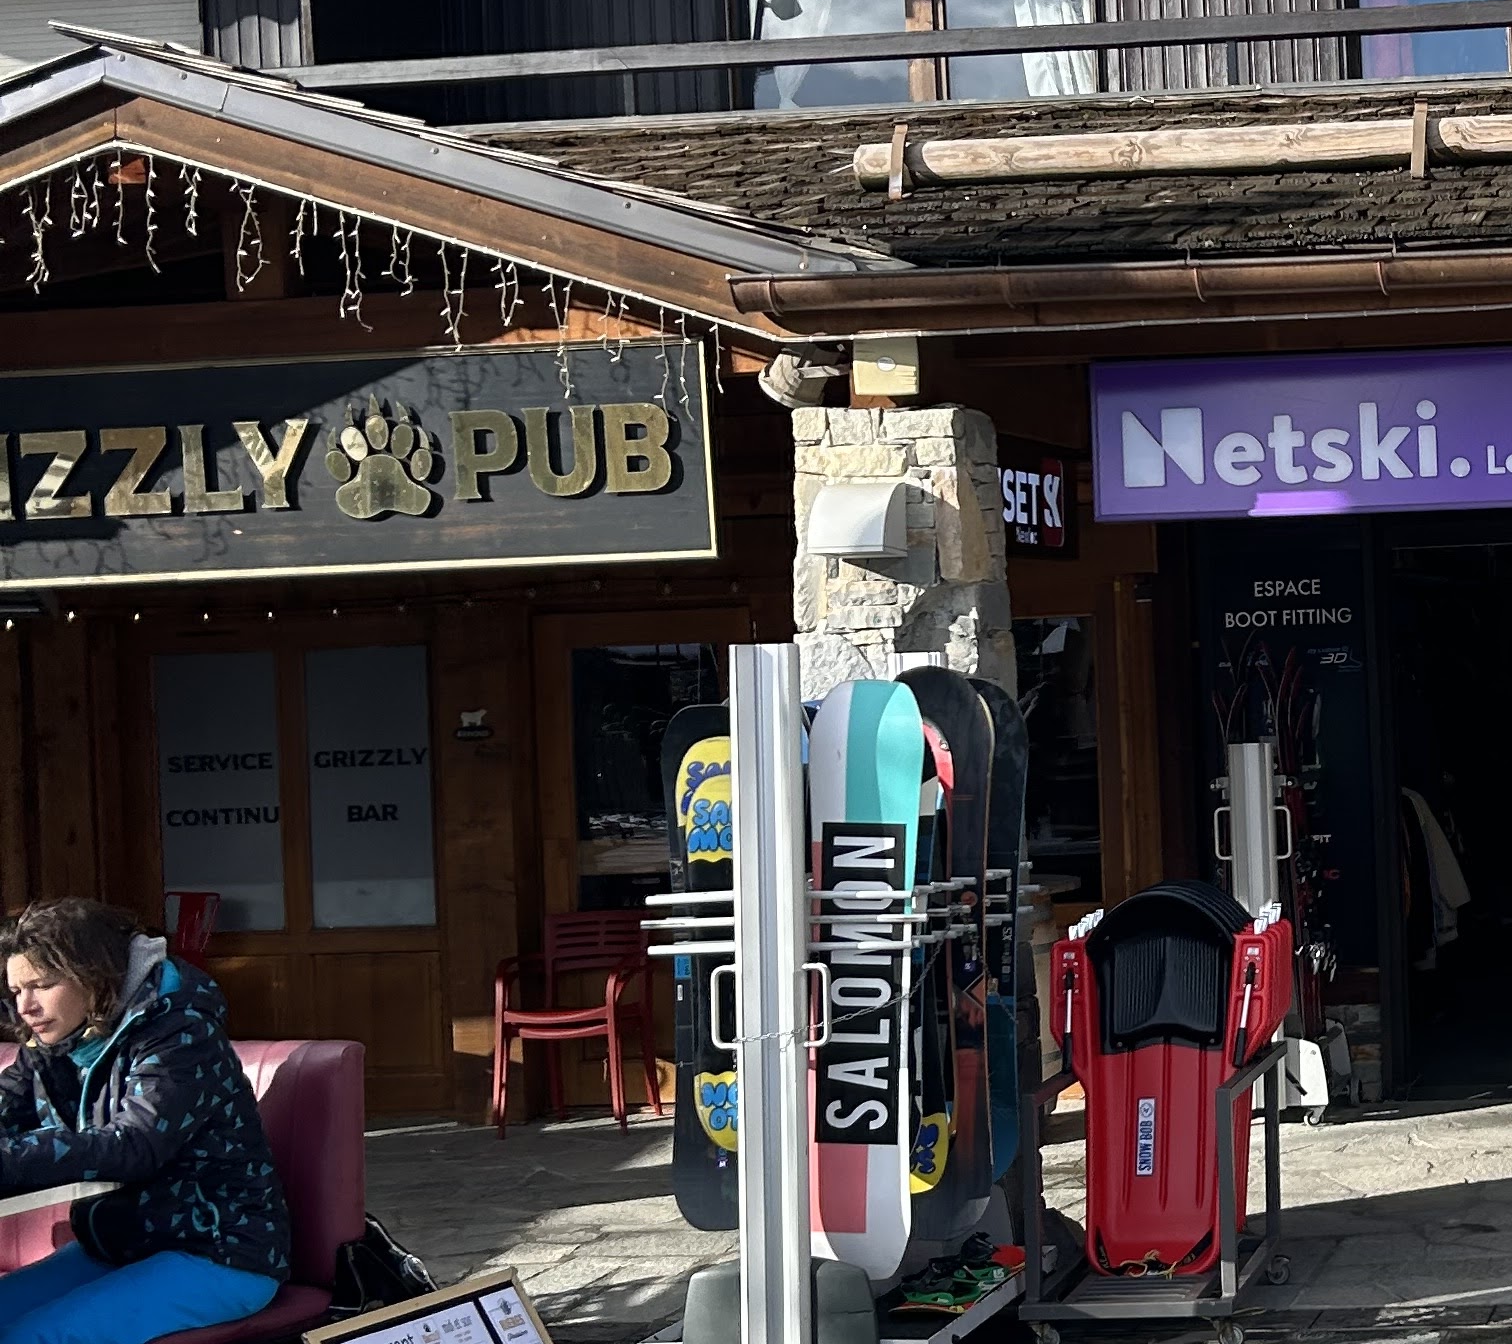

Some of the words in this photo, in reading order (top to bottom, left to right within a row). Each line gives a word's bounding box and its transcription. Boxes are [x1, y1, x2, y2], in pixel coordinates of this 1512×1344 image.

[450, 401, 673, 501] PUB
[1253, 578, 1321, 598] ESPACE
[1225, 607, 1277, 629] BOOT
[1281, 606, 1352, 627] FITTING
[167, 752, 273, 774] SERVICE
[314, 747, 428, 769] GRIZZLY
[166, 806, 280, 827] CONTINU
[347, 803, 398, 824] BAR
[826, 835, 897, 1130] SALOMON
[1140, 1120, 1153, 1141] BOB
[1138, 1142, 1153, 1171] SNOW
